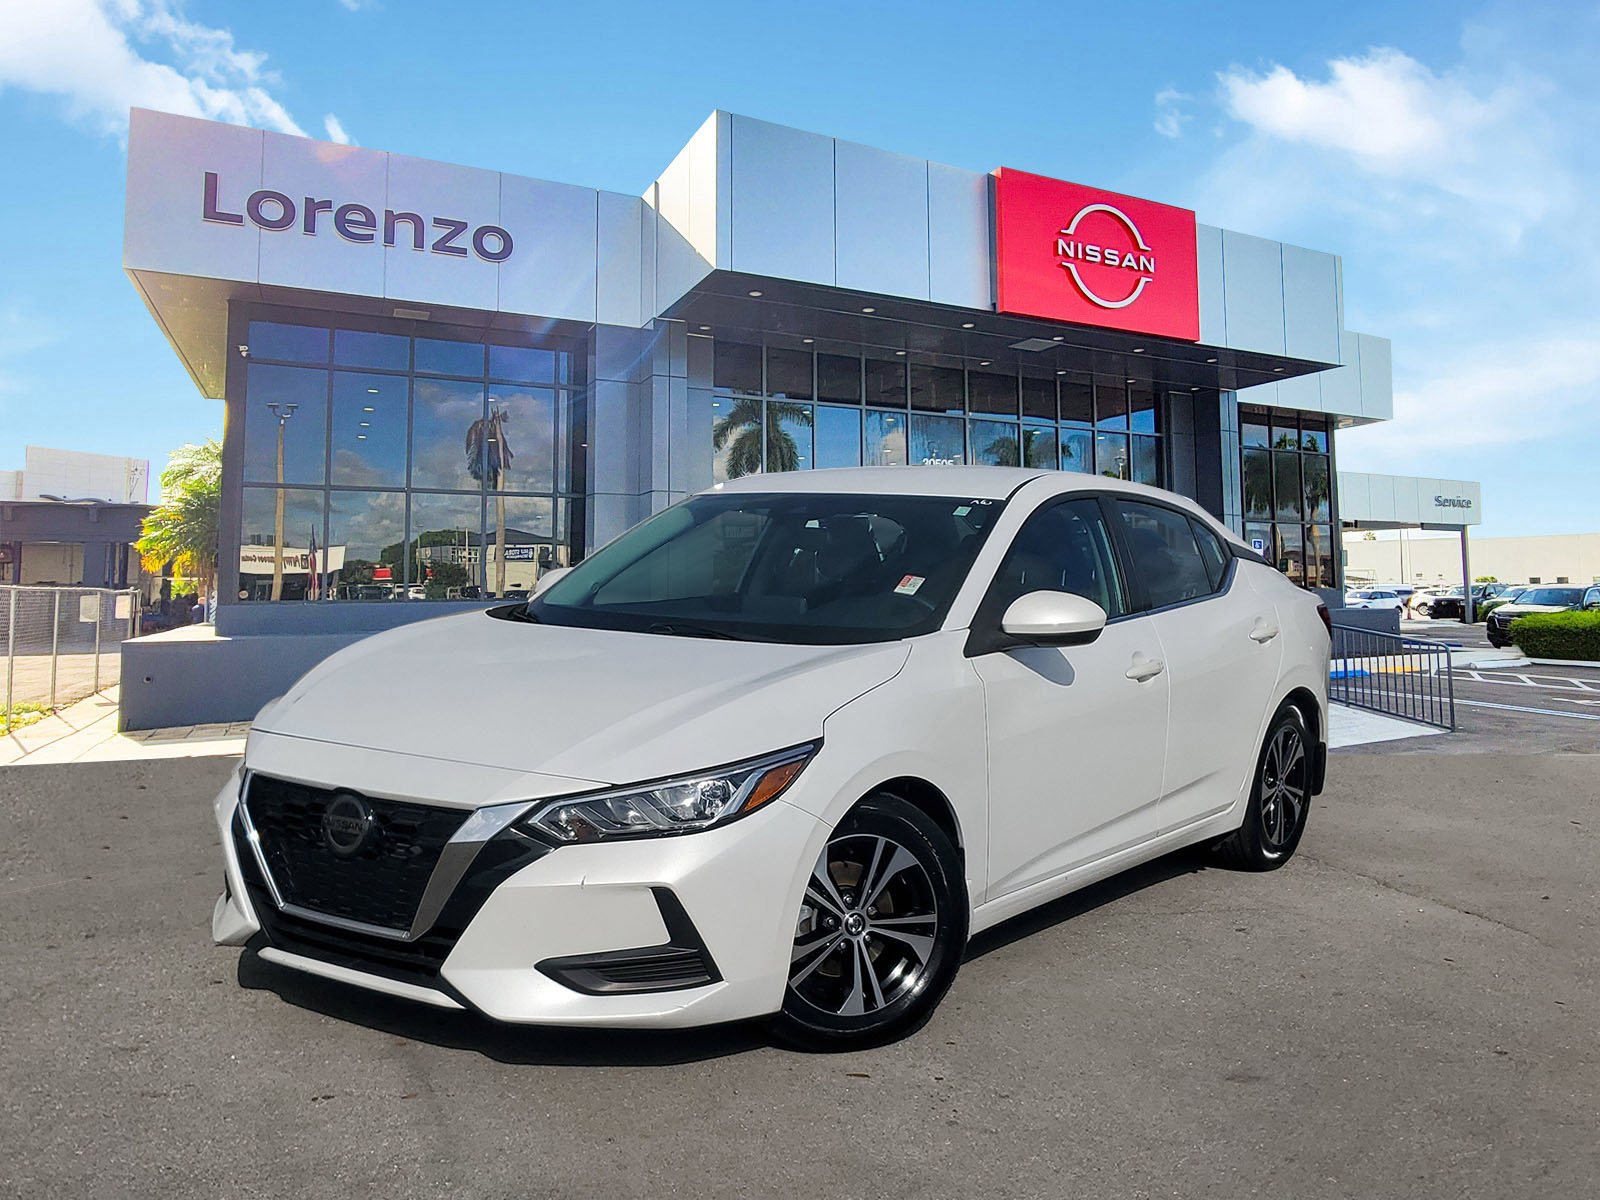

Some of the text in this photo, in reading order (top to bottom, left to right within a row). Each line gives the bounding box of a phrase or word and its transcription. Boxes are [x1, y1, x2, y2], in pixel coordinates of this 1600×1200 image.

[202, 171, 514, 262] Lorenzo
[1057, 238, 1155, 273] NISSAN
[1434, 495, 1472, 508] Service
